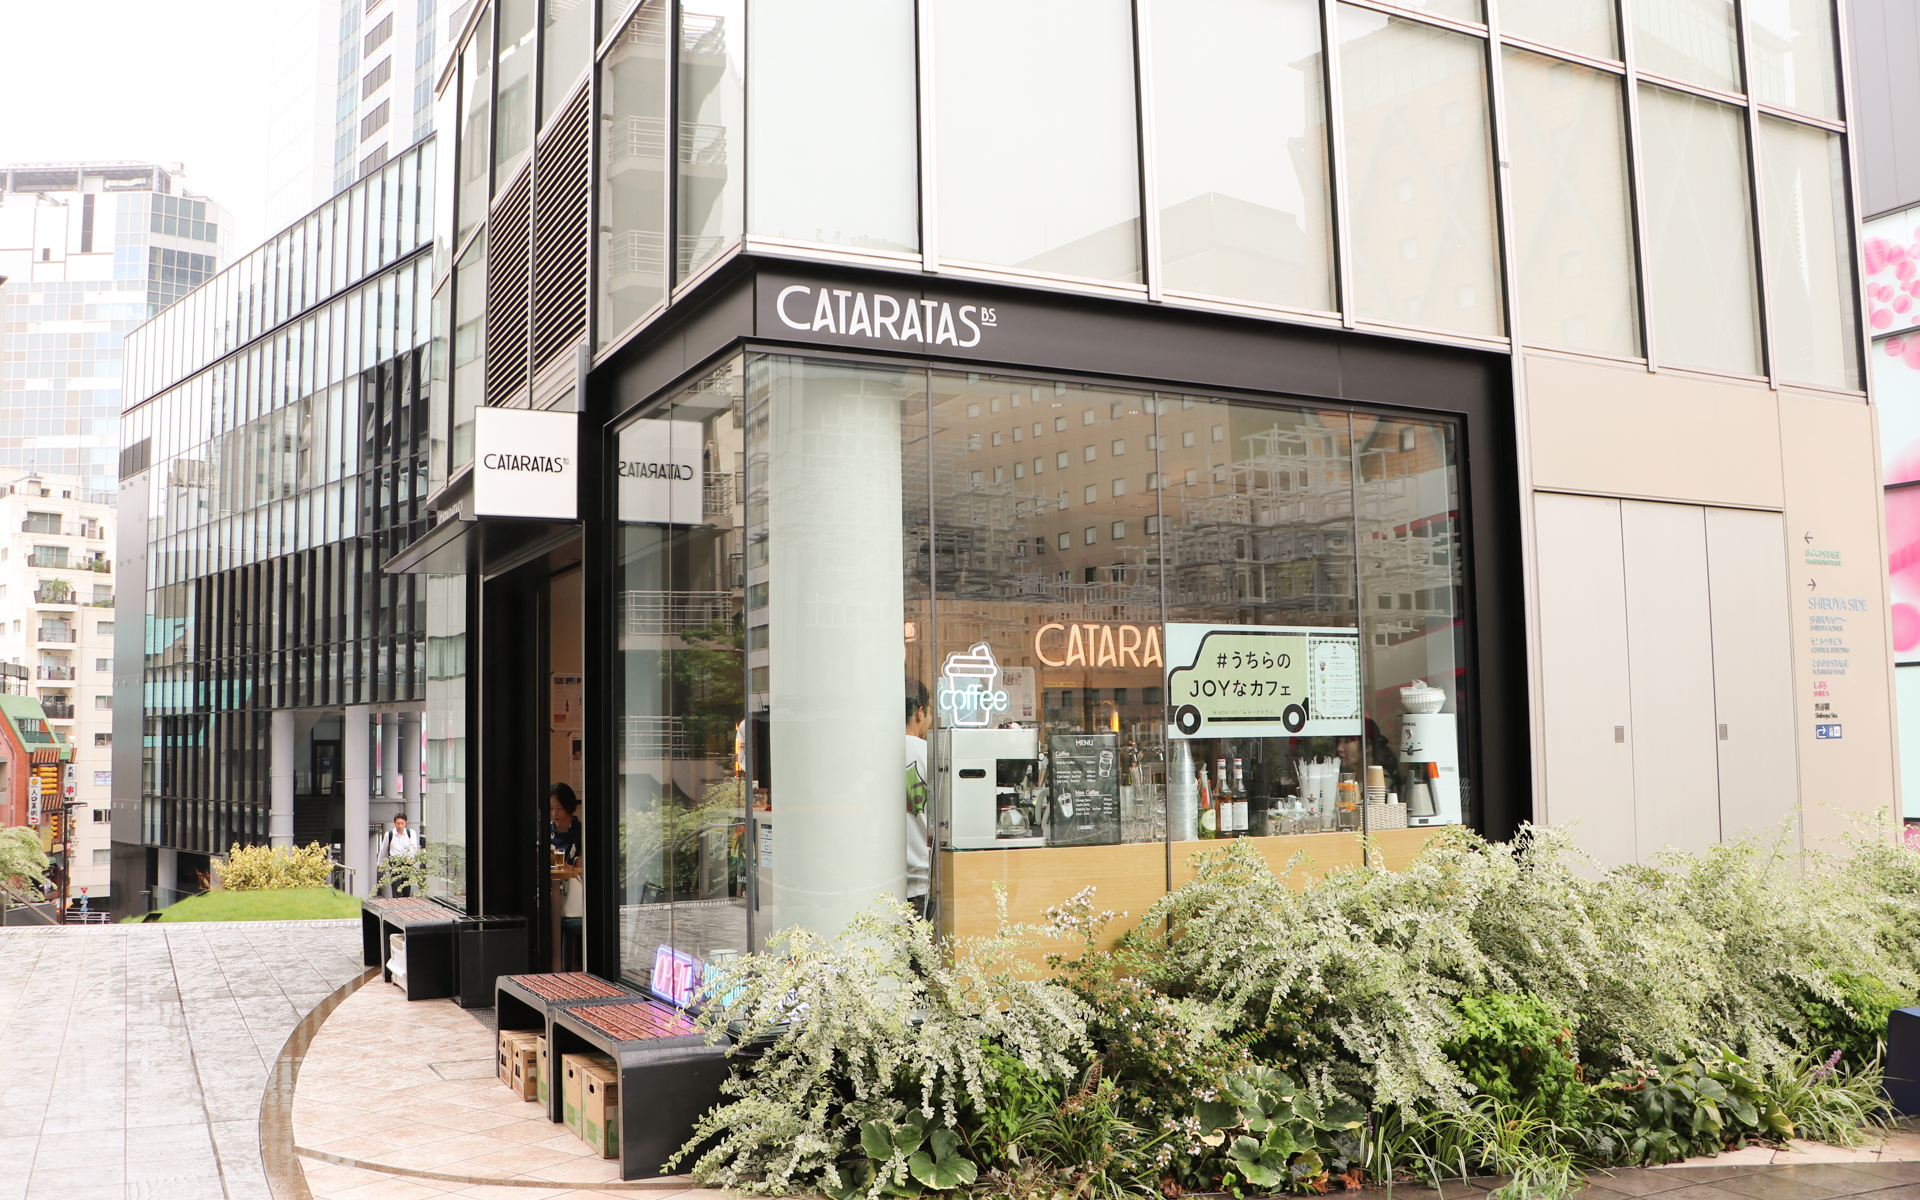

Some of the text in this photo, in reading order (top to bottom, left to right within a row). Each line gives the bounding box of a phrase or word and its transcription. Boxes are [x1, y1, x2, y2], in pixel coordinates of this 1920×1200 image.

[776, 285, 981, 348] CATARATAS
[484, 453, 563, 474] CATARATAS
[1808, 596, 1868, 611] SHIBUYA SIDE
[1034, 623, 1163, 668] CATARA
[1216, 651, 1291, 670] #うちらの
[940, 684, 1008, 711] coffee
[1189, 680, 1292, 698] JOYなカフェ
[1075, 739, 1094, 747] MENU
